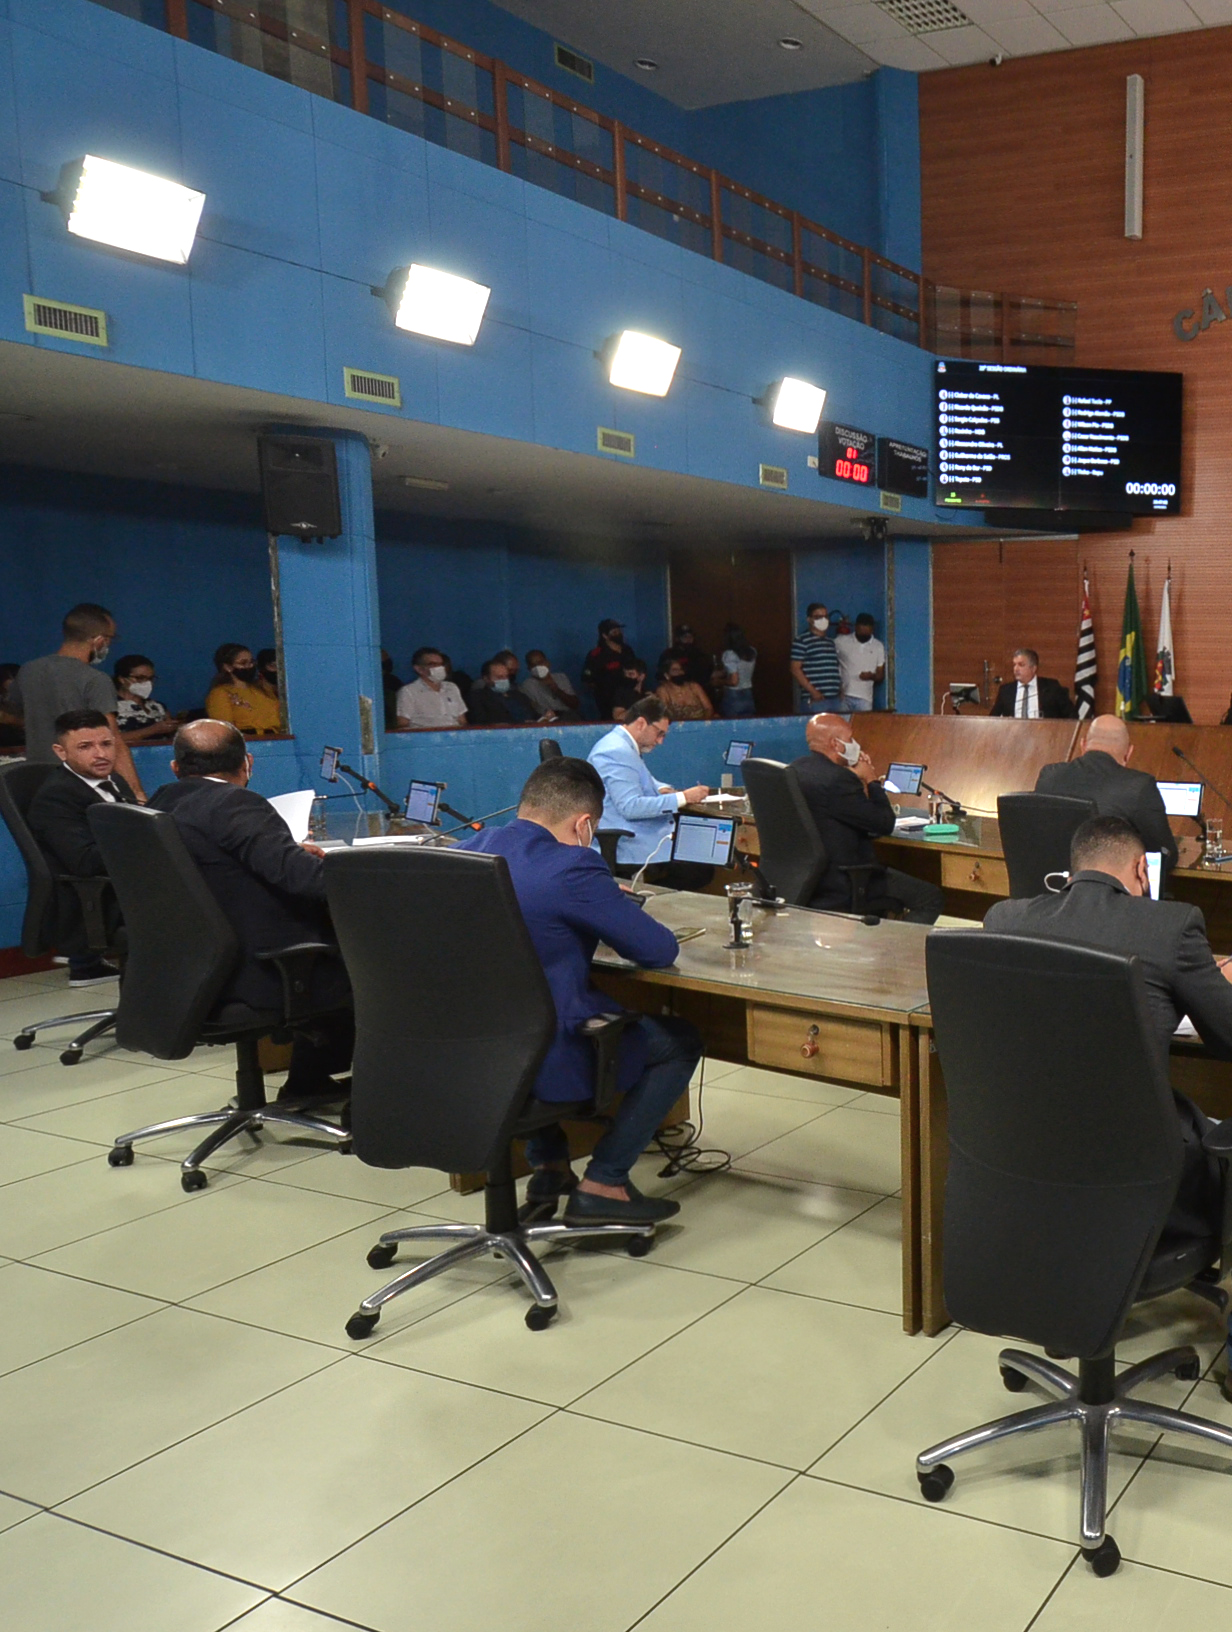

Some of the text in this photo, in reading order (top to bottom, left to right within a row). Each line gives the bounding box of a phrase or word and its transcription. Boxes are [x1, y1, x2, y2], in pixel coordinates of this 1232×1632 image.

[835, 426, 868, 443] DISCUSSÃO
[838, 437, 865, 450] VOTAÇÃO
[835, 459, 869, 483] 00:00
[1125, 481, 1176, 496] 00:00:00
